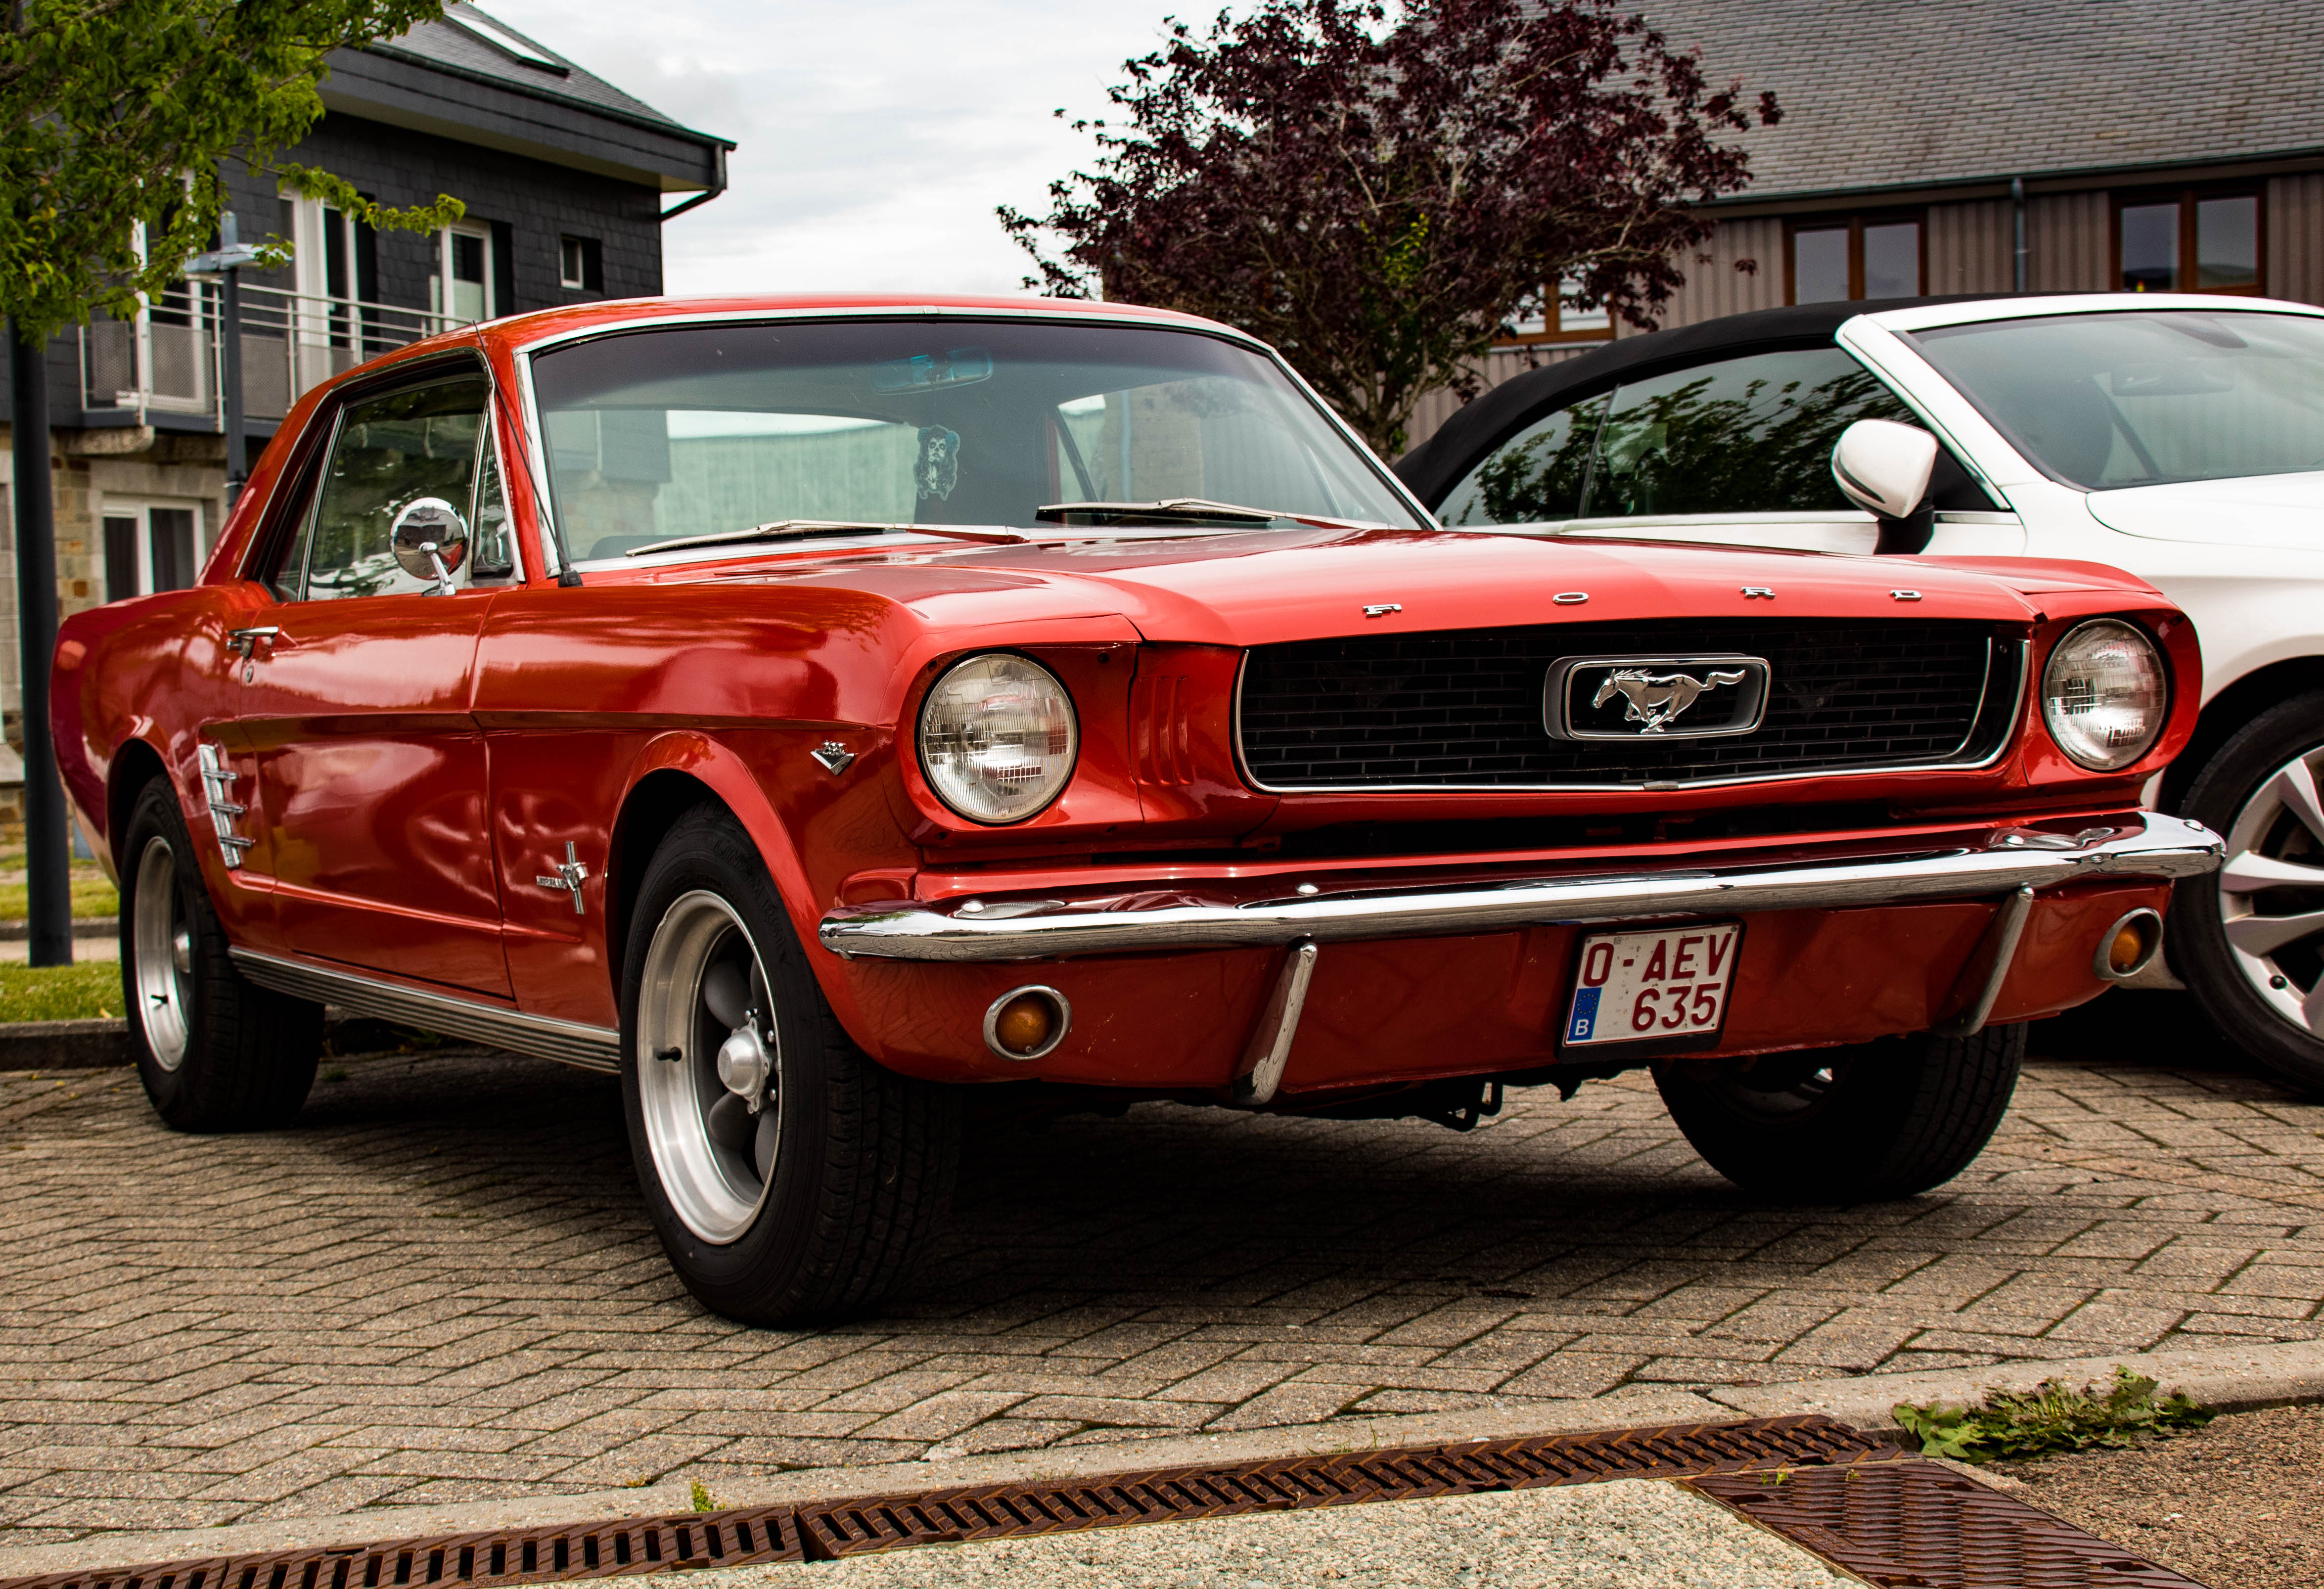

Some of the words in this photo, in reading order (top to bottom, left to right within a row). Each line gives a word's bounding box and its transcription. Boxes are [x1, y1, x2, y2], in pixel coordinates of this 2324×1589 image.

[1363, 587, 1922, 617] FORD
[1632, 983, 1722, 1032] 635
[1575, 1019, 1589, 1036] B
